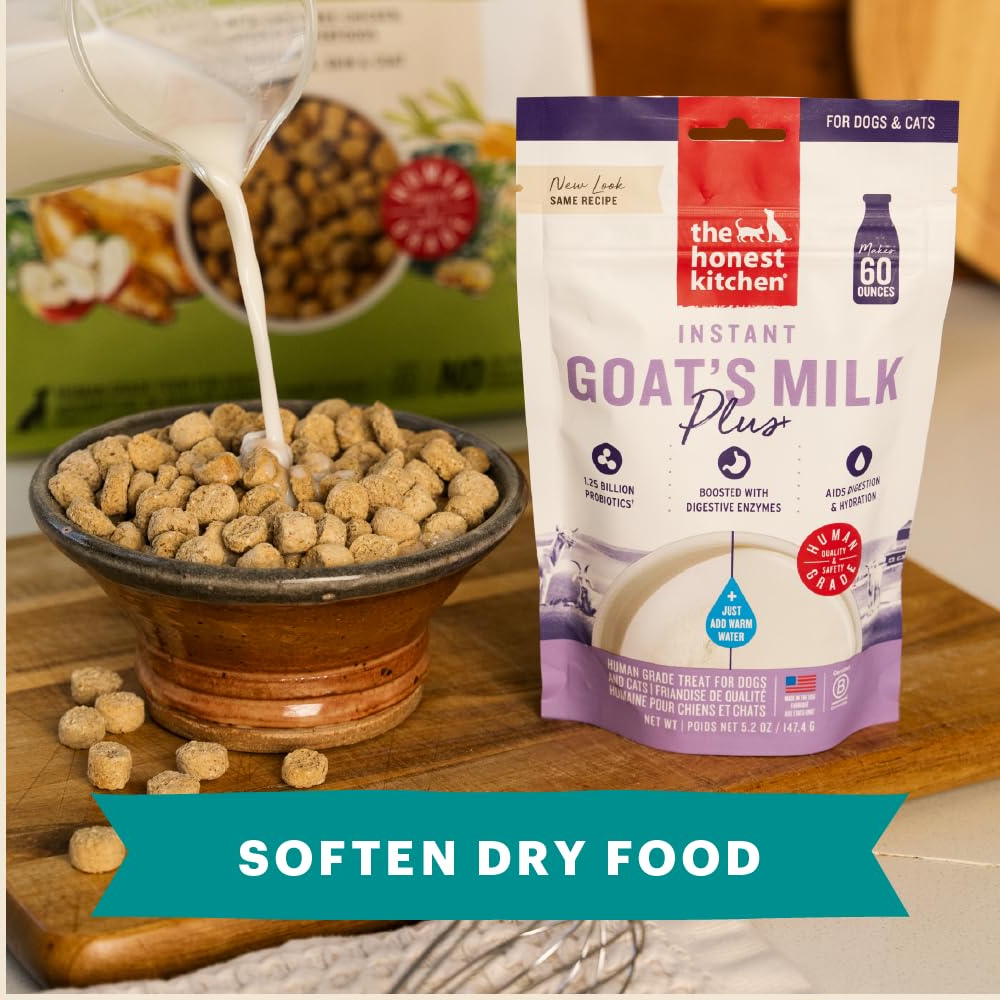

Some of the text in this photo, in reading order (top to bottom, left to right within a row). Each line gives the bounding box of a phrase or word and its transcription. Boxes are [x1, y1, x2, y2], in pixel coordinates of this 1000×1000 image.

[826, 115, 935, 130] FOR DOGS & CATS
[549, 174, 626, 194] New Look
[550, 195, 618, 206] SAME RECIPE
[691, 220, 732, 243] the
[691, 246, 785, 269] honest
[860, 257, 892, 285] 60
[857, 286, 895, 298] OUNCES
[678, 324, 796, 344] INSTANT
[773, 356, 904, 407] MILK
[583, 477, 635, 495] 1.25 BILLION
[700, 488, 769, 498] BOOSTED WITH
[825, 476, 881, 498] AIDS DIGESTION
[686, 502, 782, 513] DIGESTIVE ENZYMES
[830, 491, 877, 512] & HYDRATION
[806, 528, 858, 555] HUMAN
[821, 547, 847, 558] QUALITY
[806, 563, 856, 591] GRADE
[822, 564, 845, 574] SAFETY
[721, 605, 742, 616] JUST
[710, 618, 753, 629] ADD WARM
[718, 631, 745, 642] WATER
[607, 658, 767, 689] HUMAN GRADE TREAT FOR DOGS
[608, 673, 766, 703] AND CATS FRIANDISE DE QUALITÉ
[609, 686, 766, 717] HUMAINE POUR CHIENS ET CHATS
[644, 714, 660, 727] NET
[664, 717, 678, 729] WT
[687, 721, 717, 732] POIDS
[720, 721, 738, 733] NET
[741, 721, 757, 733] 5.2
[759, 722, 772, 733] OZ
[783, 721, 807, 733] 147.4
